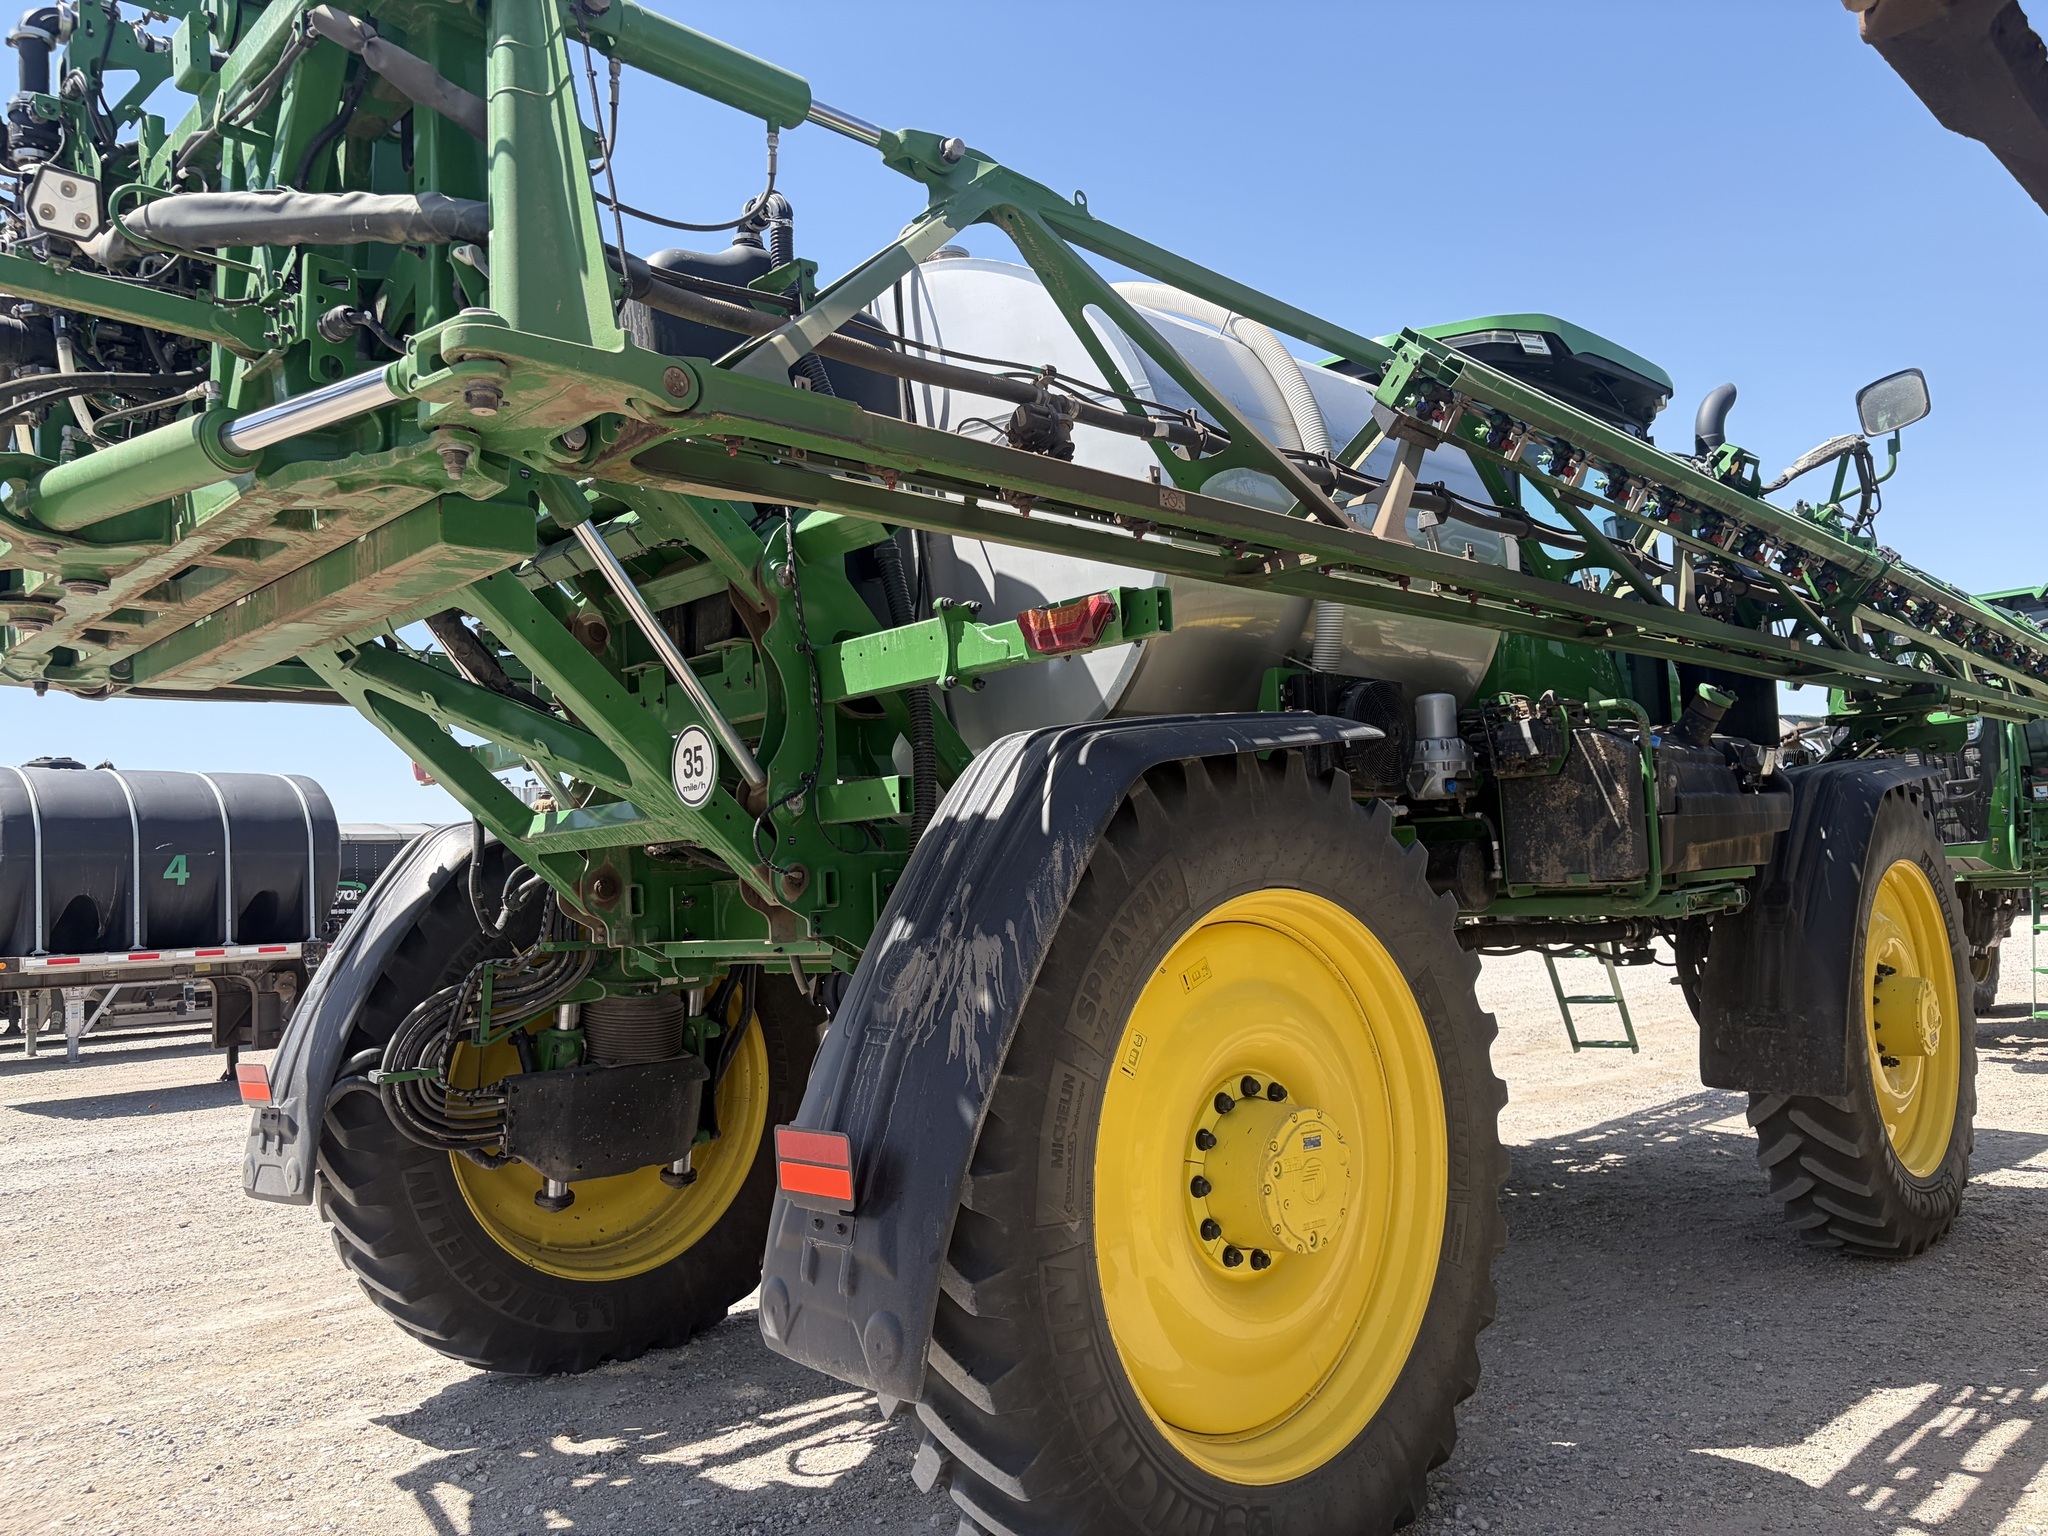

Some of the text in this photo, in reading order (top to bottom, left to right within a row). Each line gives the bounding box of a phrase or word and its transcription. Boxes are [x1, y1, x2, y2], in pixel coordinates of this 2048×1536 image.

[683, 745, 704, 779] 35
[683, 781, 706, 792] mile/h
[163, 854, 190, 886] 4
[1927, 864, 1958, 946] MICHELIN
[1076, 868, 1173, 1027] SPRAYBIB
[1093, 1007, 1110, 1041] VF
[1050, 1072, 1076, 1169] MICHELIN
[1072, 1081, 1086, 1130] Technologies
[405, 1170, 560, 1326] MICHELIN
[1044, 1264, 1217, 1536] MICHELIN
